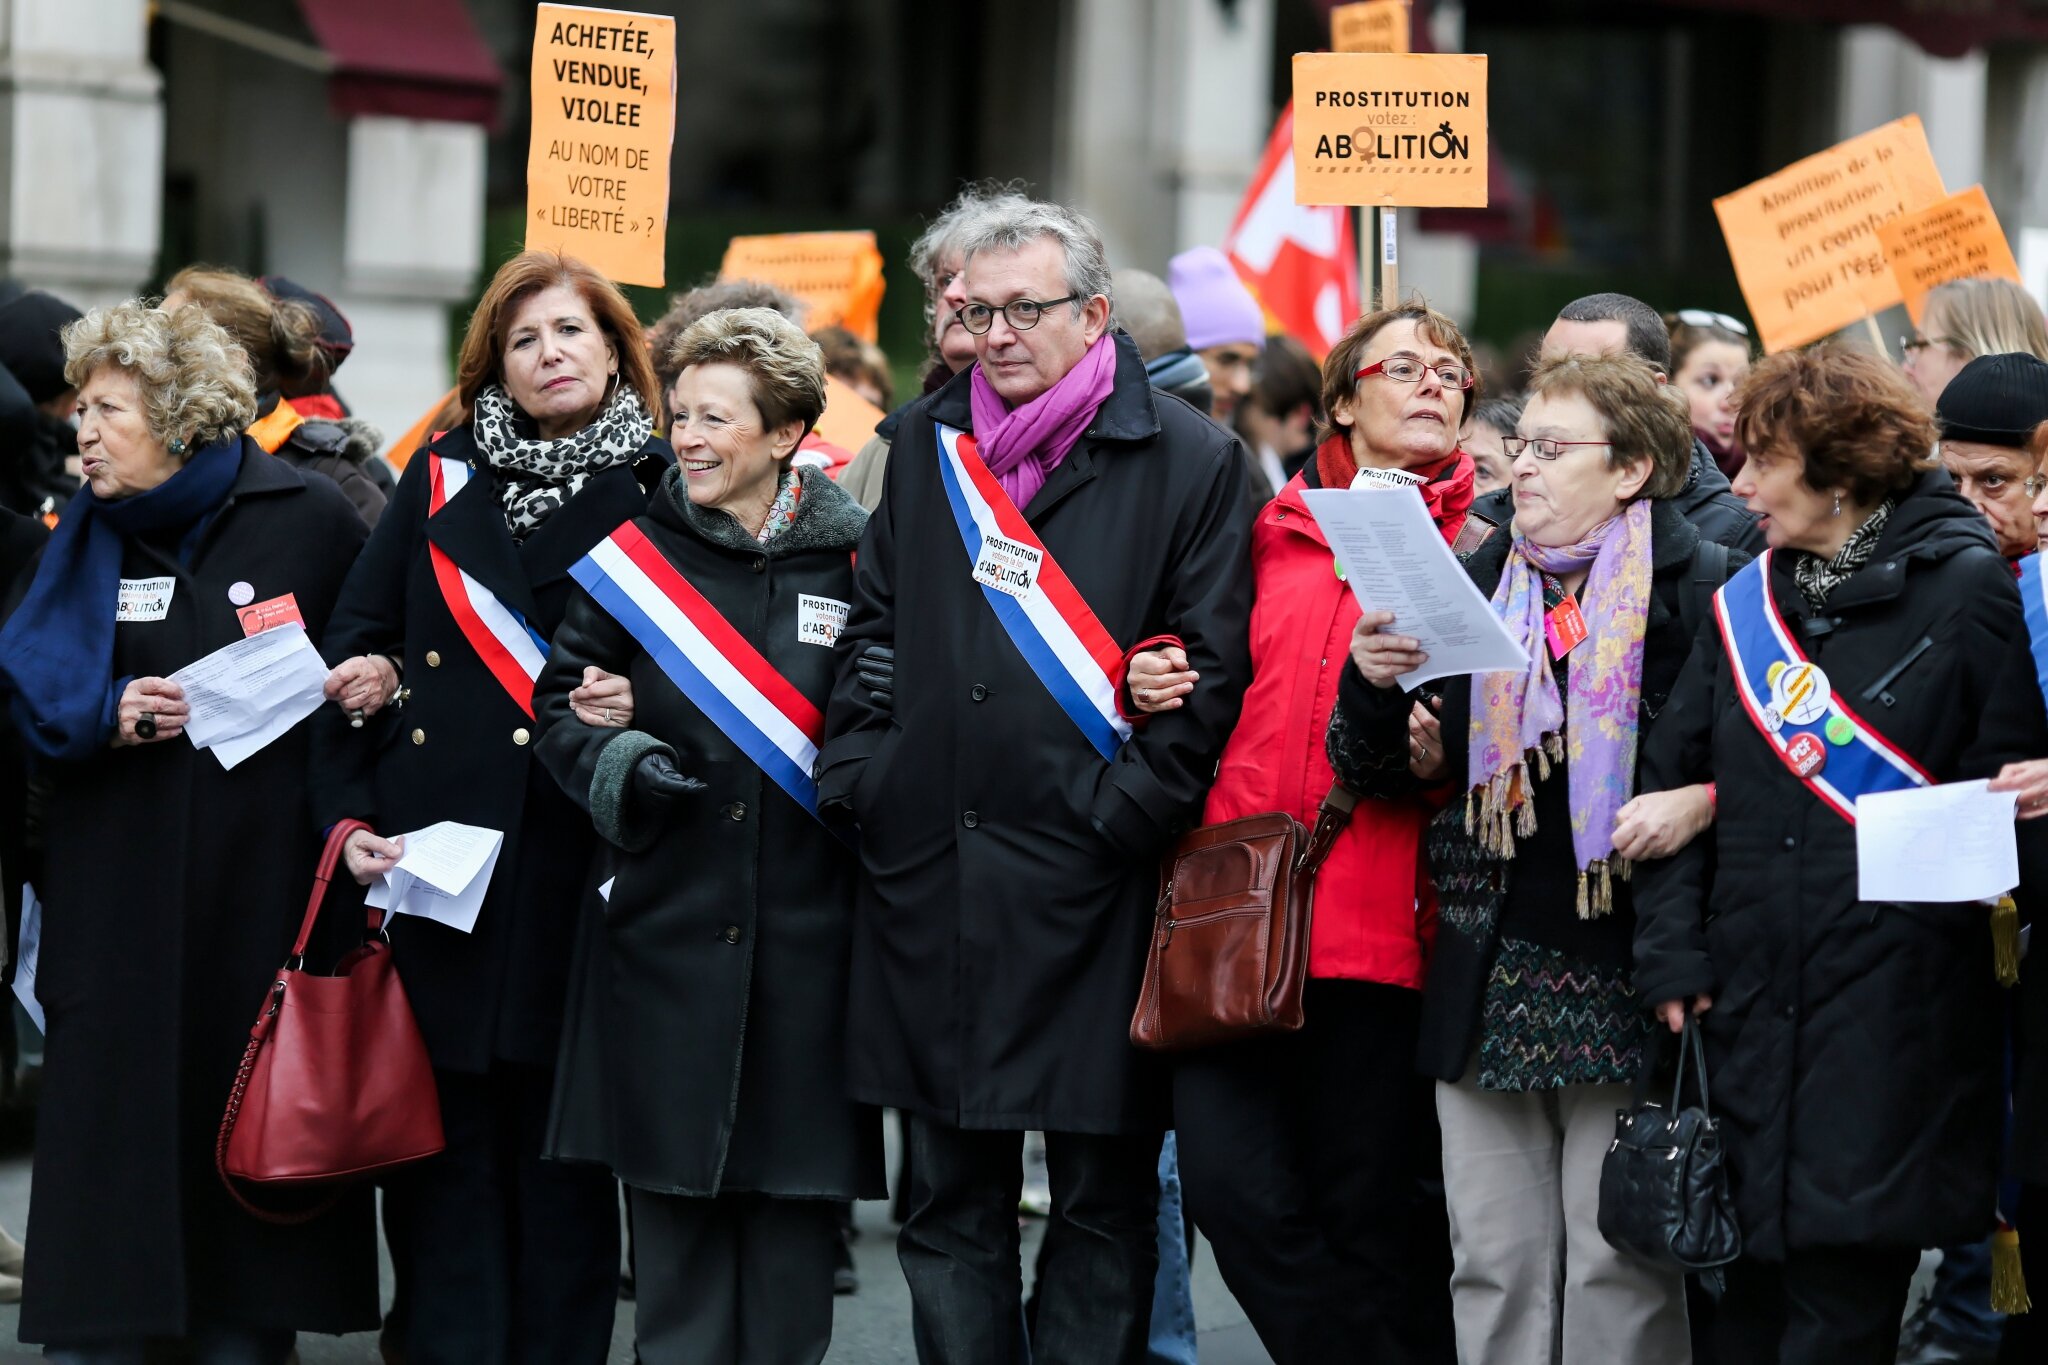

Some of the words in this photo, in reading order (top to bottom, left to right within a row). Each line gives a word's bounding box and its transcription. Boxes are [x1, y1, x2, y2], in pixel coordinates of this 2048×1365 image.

[550, 21, 655, 60] ACHETÉE,
[553, 58, 648, 96] VENDUE,
[562, 96, 641, 127] VIOLEE
[1316, 91, 1470, 107] PROSTITUTION
[1367, 111, 1408, 125] votez
[549, 140, 573, 162] AU
[579, 142, 619, 168] NOM
[625, 148, 649, 171] DE
[1315, 123, 1469, 162] ABOLITION
[568, 174, 627, 201] VOTRE
[1761, 169, 1842, 214] Abolition
[1848, 157, 1869, 174] de
[1875, 146, 1894, 163] la
[552, 205, 625, 234] LIBERTÉ
[1777, 182, 1884, 240] prostitution
[1786, 244, 1815, 269] un
[1783, 271, 1834, 311] pour
[985, 535, 1039, 563] PROSTITUTION
[979, 560, 1032, 589] d'ABOLITION
[803, 599, 849, 616] PROSTITUT
[816, 612, 836, 622] votons
[803, 622, 842, 639] d'ABOLI
[1789, 737, 1811, 762] PCF
